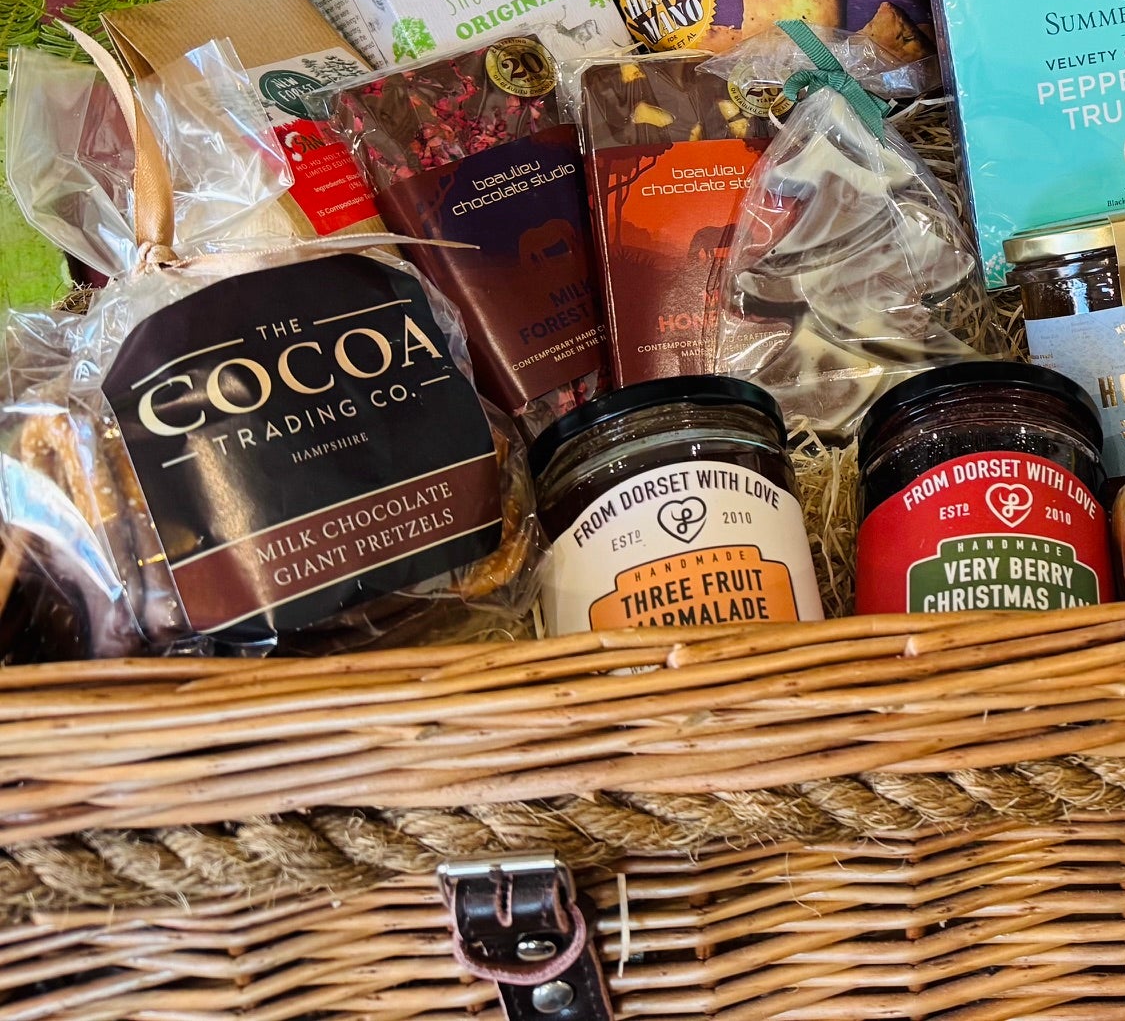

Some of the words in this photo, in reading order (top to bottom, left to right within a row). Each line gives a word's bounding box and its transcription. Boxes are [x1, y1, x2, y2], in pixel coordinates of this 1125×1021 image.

[1046, 49, 1118, 71] VELVETY
[452, 181, 530, 217] chocolate
[530, 161, 577, 188] studio
[472, 159, 541, 191] beaulieu
[255, 318, 303, 341] THE
[137, 314, 443, 438] COCOA
[212, 399, 358, 456] TRADING
[371, 382, 417, 408] CO.
[291, 431, 369, 465] HAMPSHIRE
[256, 529, 318, 565] MILK
[322, 481, 454, 540] CHOCOLATE
[274, 546, 349, 587] GIANT
[355, 508, 455, 556] PRETZELS
[621, 577, 694, 619] THREE
[703, 569, 763, 596] FRUIT
[944, 557, 1000, 585] VERY
[1010, 557, 1073, 589] BERRY
[923, 585, 1049, 613] CHRISTMAS
